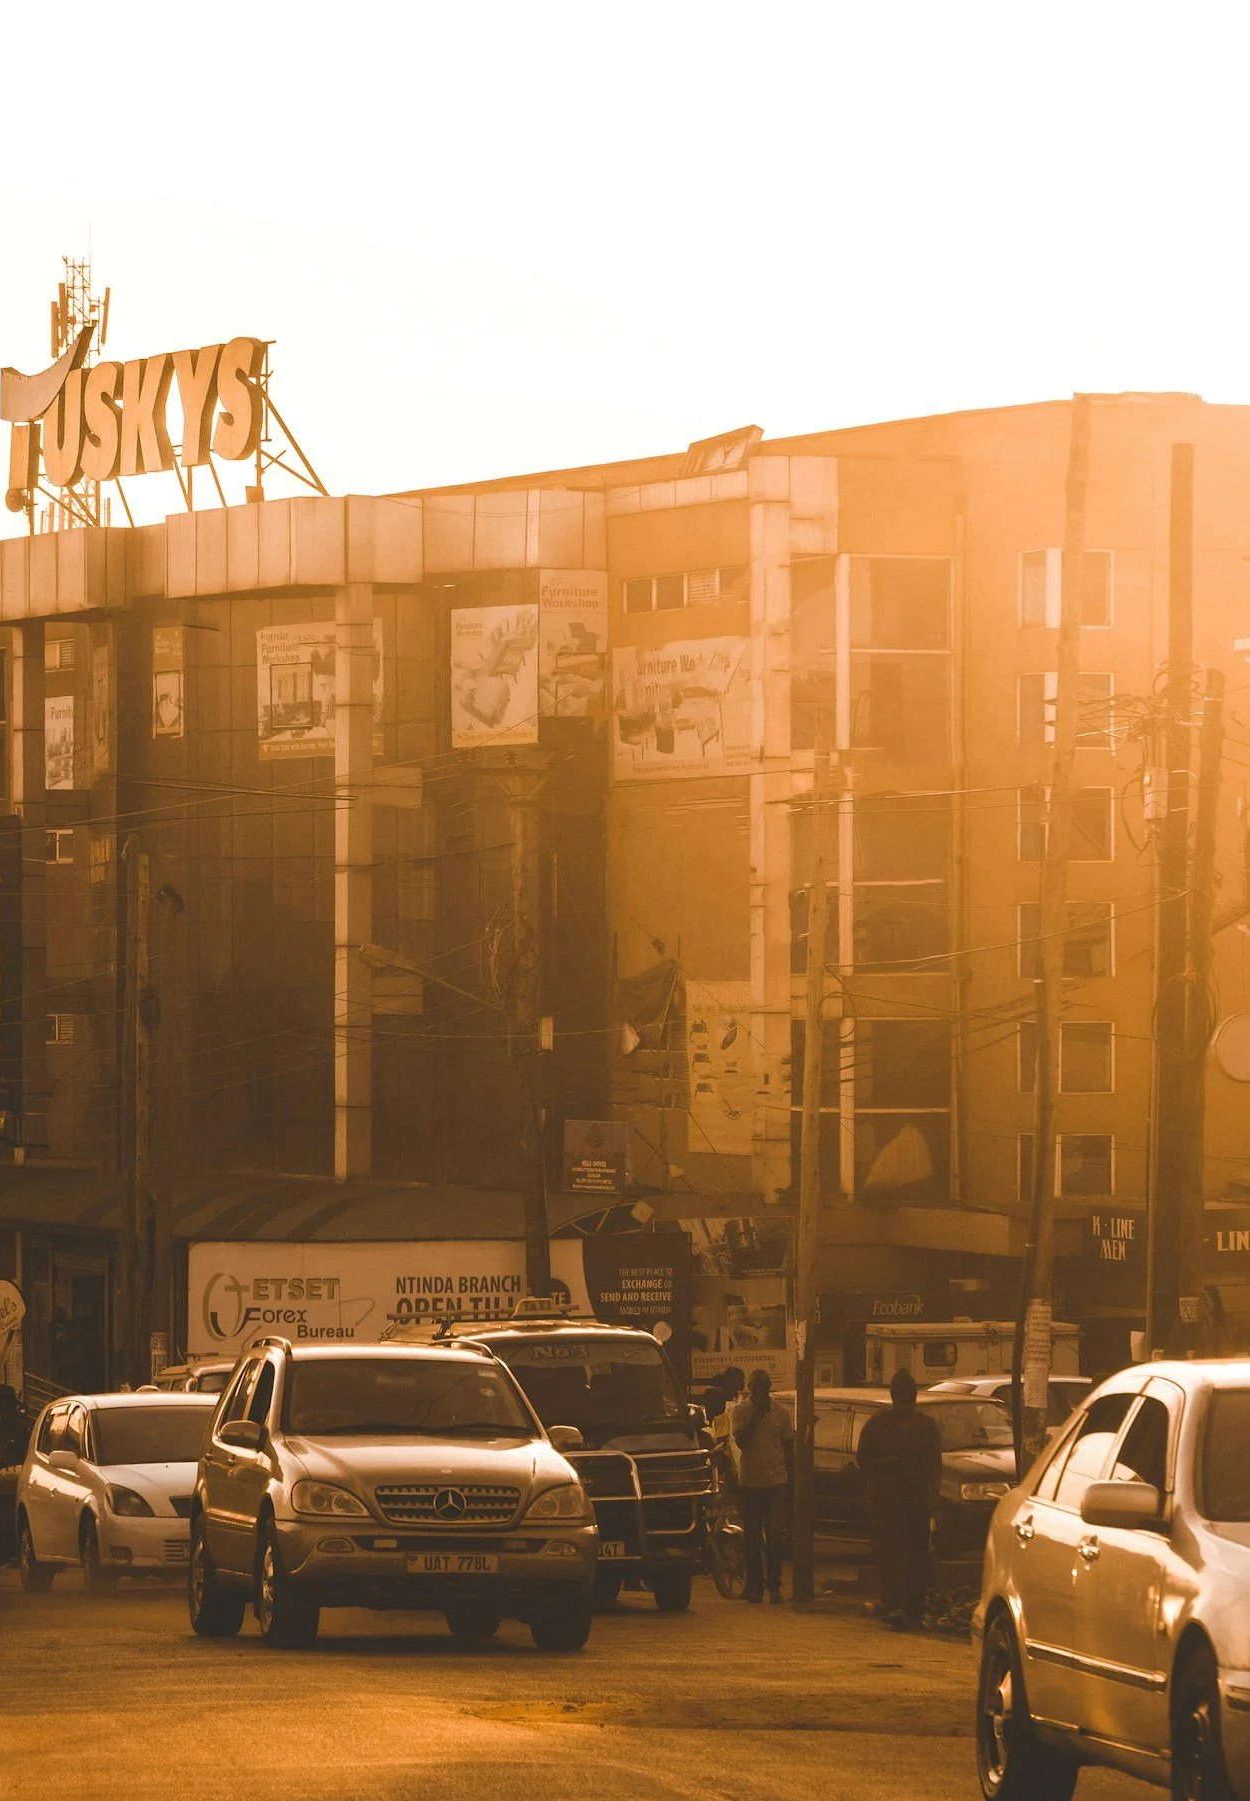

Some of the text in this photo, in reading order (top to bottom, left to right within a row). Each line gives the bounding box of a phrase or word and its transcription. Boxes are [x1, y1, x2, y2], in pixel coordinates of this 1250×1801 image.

[0, 327, 263, 492] TUSKYS
[542, 586, 599, 597] Furniture
[542, 598, 599, 610] Workshop
[261, 643, 300, 654] Furniture
[262, 654, 301, 665] Workshop
[1101, 1239, 1126, 1261] MEN
[619, 1268, 673, 1276] THE BEST PLACE TO
[396, 1275, 521, 1294] NTINDA BRANCH
[622, 1279, 662, 1289] EXCHANGE
[601, 1291, 672, 1302] SEND AND RECEIVE
[524, 1301, 552, 1312] TAXI
[873, 1300, 924, 1316] Ecobank
[233, 1307, 307, 1338] Forex
[297, 1325, 355, 1338] Bureau
[424, 1556, 491, 1571] UAT 778L
